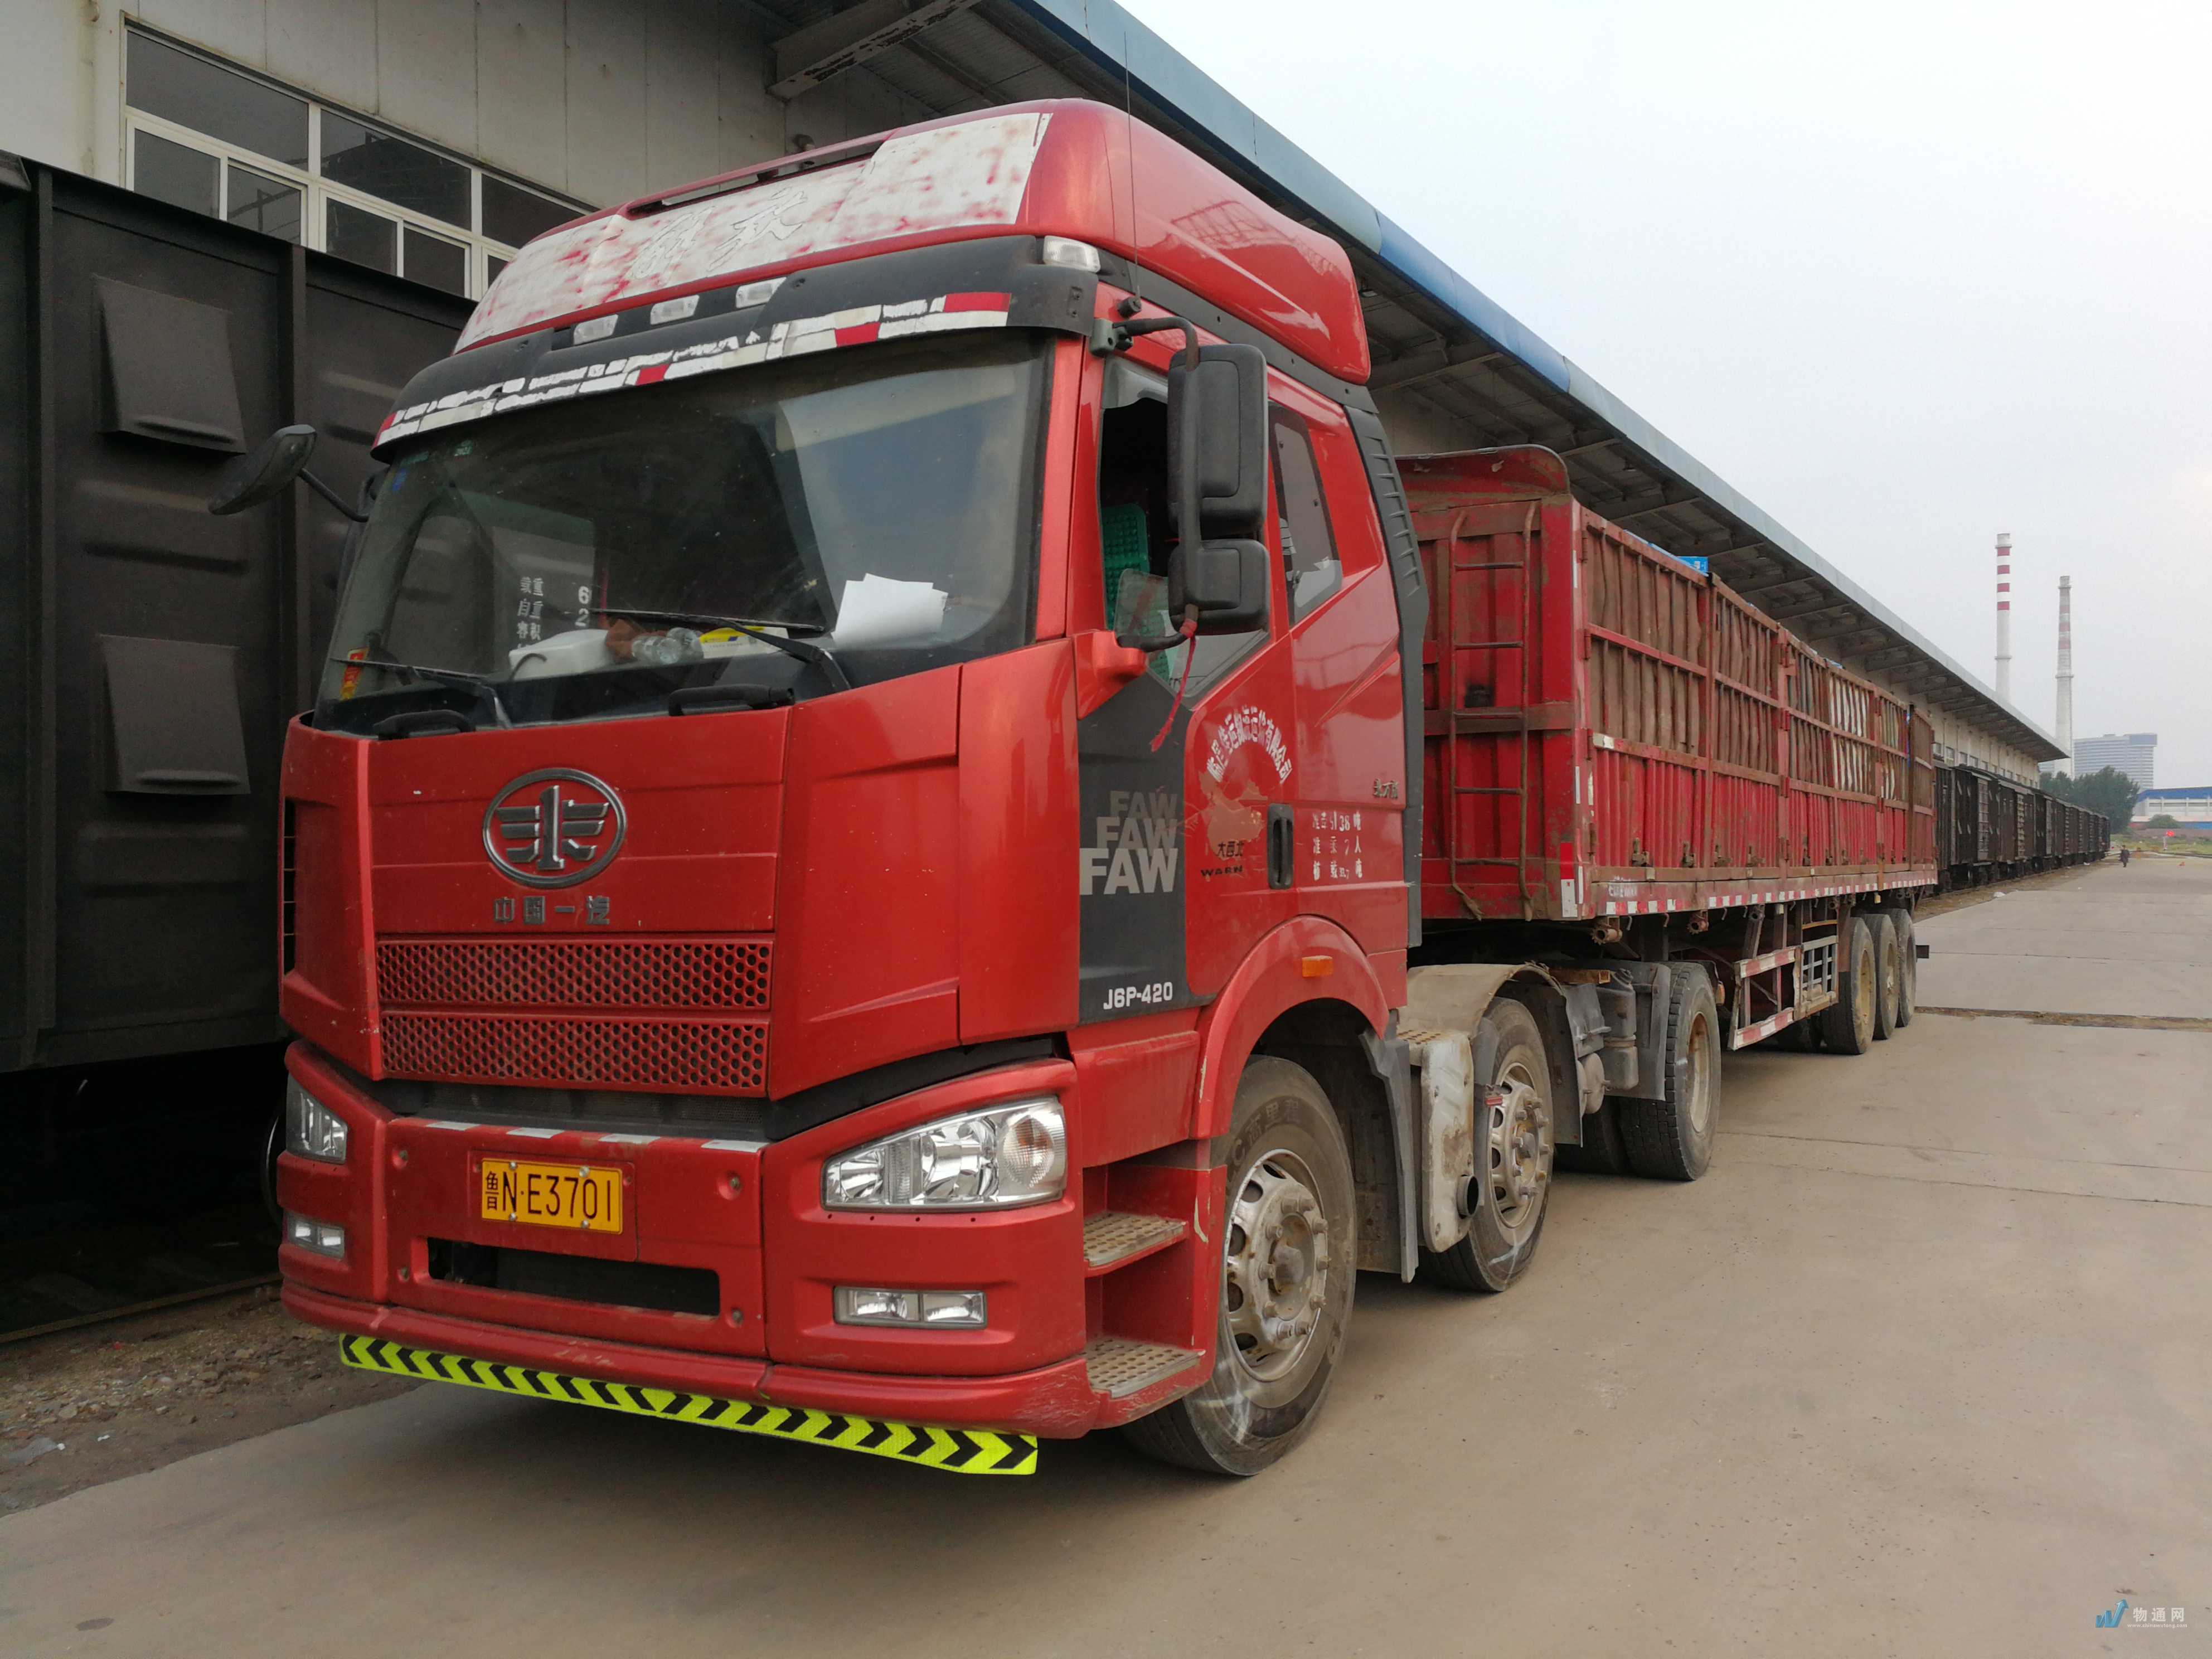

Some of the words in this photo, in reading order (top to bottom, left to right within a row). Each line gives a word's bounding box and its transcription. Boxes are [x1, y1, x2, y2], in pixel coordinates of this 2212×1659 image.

[1110, 790, 1177, 819] FAW
[1097, 817, 1178, 857] FAW
[1079, 848, 1178, 895] FAW
[492, 895, 610, 925] 中国一汽
[1103, 981, 1173, 1010] J6P-420
